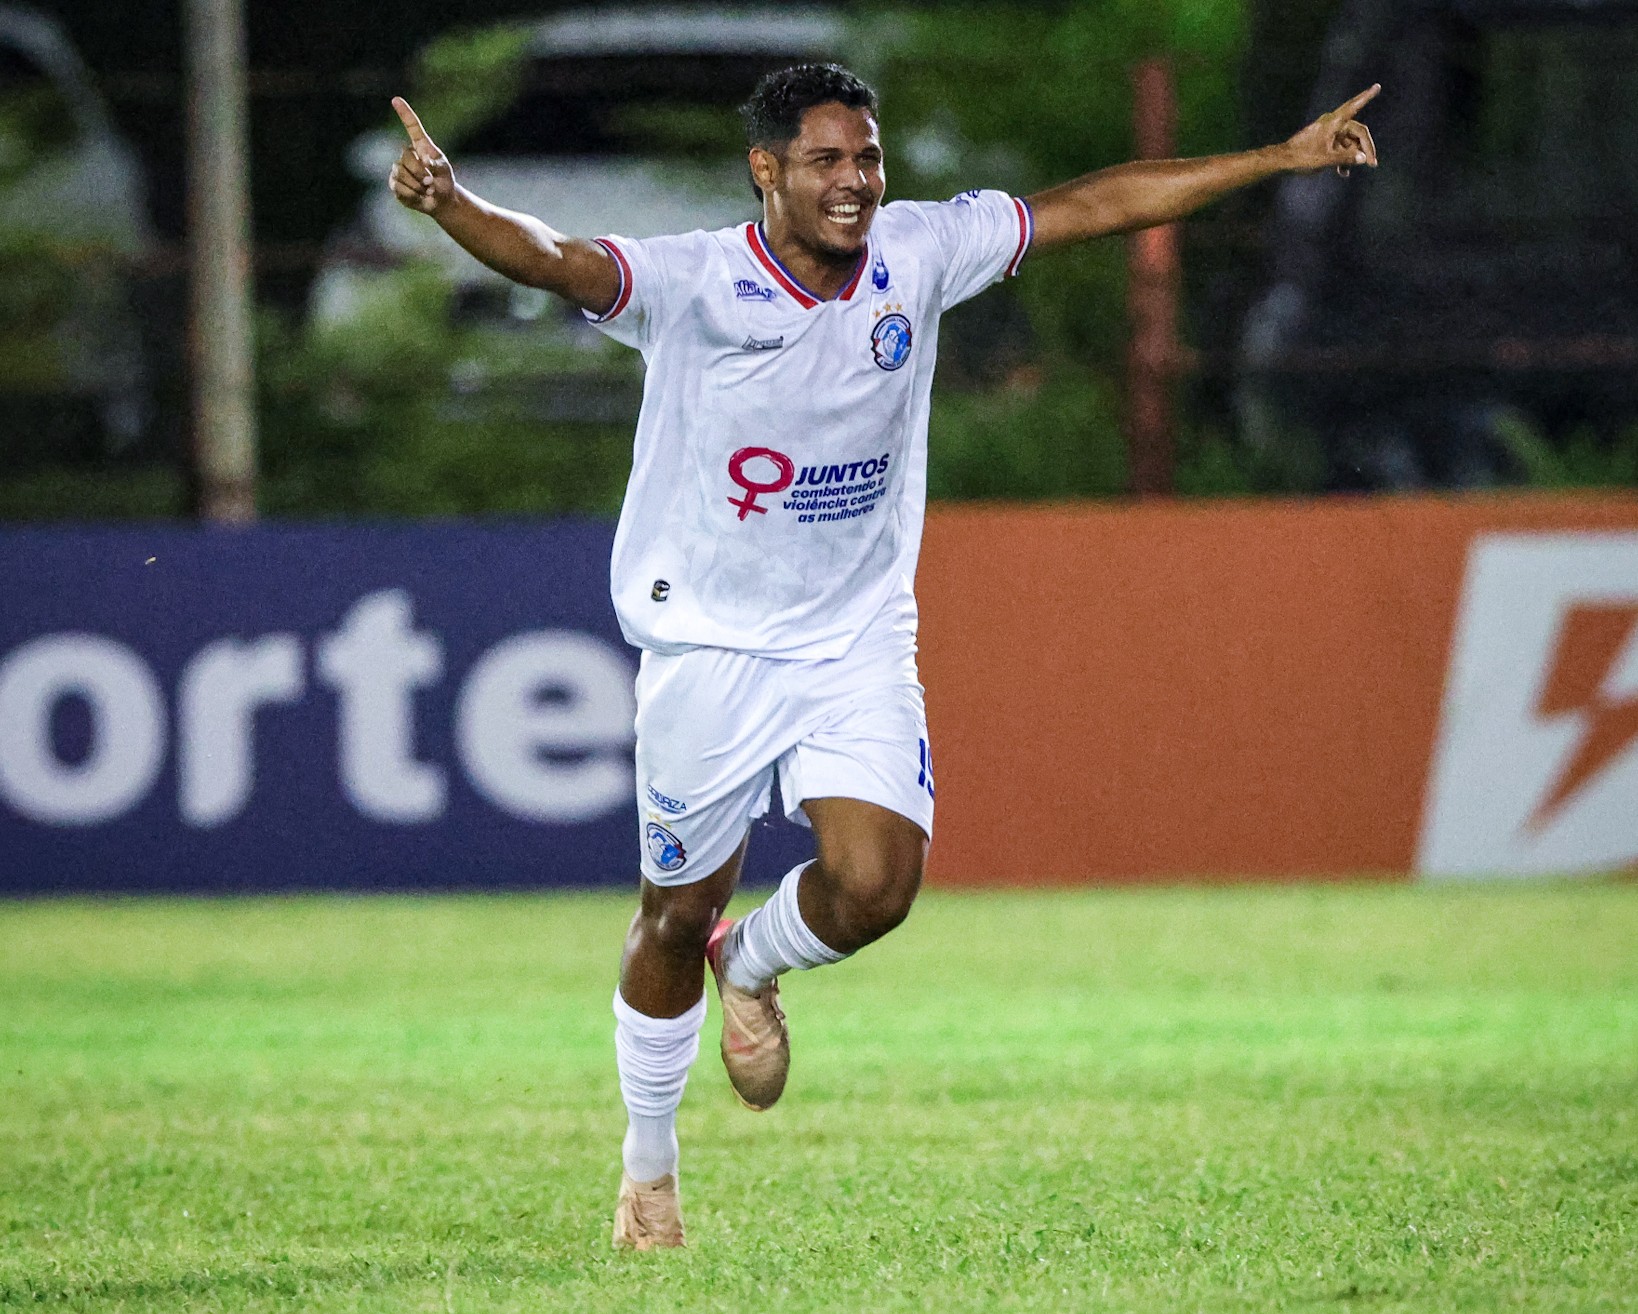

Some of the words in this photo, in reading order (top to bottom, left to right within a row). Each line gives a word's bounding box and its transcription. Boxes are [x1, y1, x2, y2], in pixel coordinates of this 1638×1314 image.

[795, 453, 890, 486] JUNTOS
[783, 497, 848, 511] violência
[850, 486, 887, 506] contra
[791, 479, 877, 498] combatendo
[798, 513, 816, 523] as
[817, 502, 876, 523] mulheres
[0, 587, 637, 829] orte
